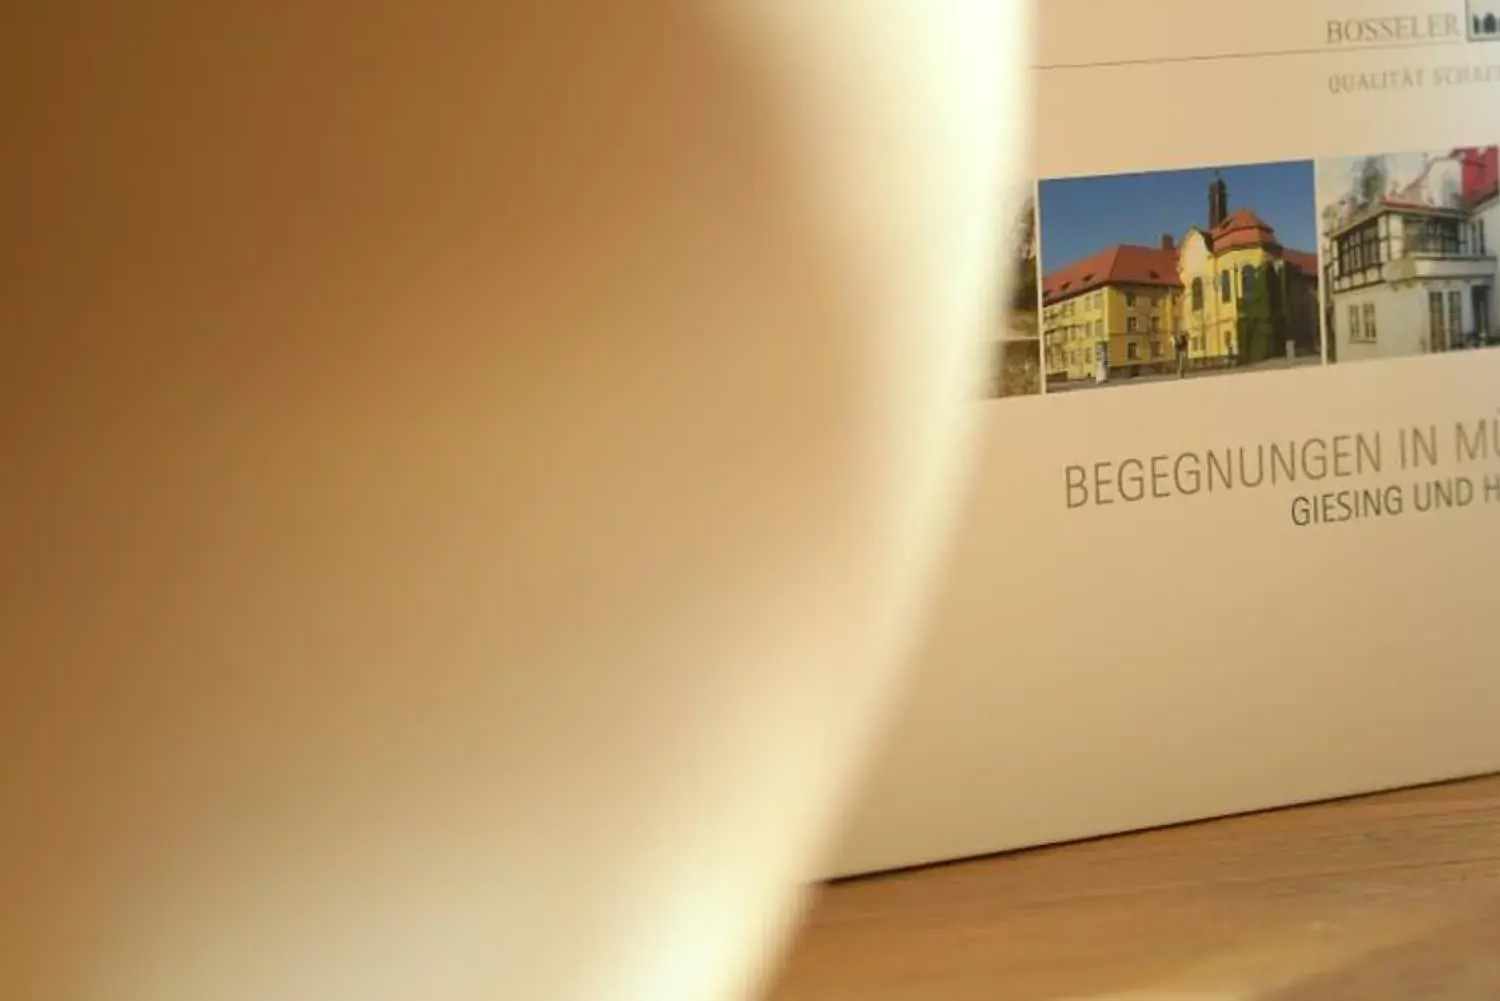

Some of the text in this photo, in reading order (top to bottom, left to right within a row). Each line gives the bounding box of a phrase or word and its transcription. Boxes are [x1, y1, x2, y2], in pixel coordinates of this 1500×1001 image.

[1325, 11, 1461, 44] BOSSELER
[1327, 66, 1425, 95] QUALITÄT
[1064, 430, 1382, 510] BEGEGNUNGEN
[1397, 423, 1439, 470] IN
[1290, 485, 1404, 527] GIESING
[1414, 476, 1474, 514] UND
